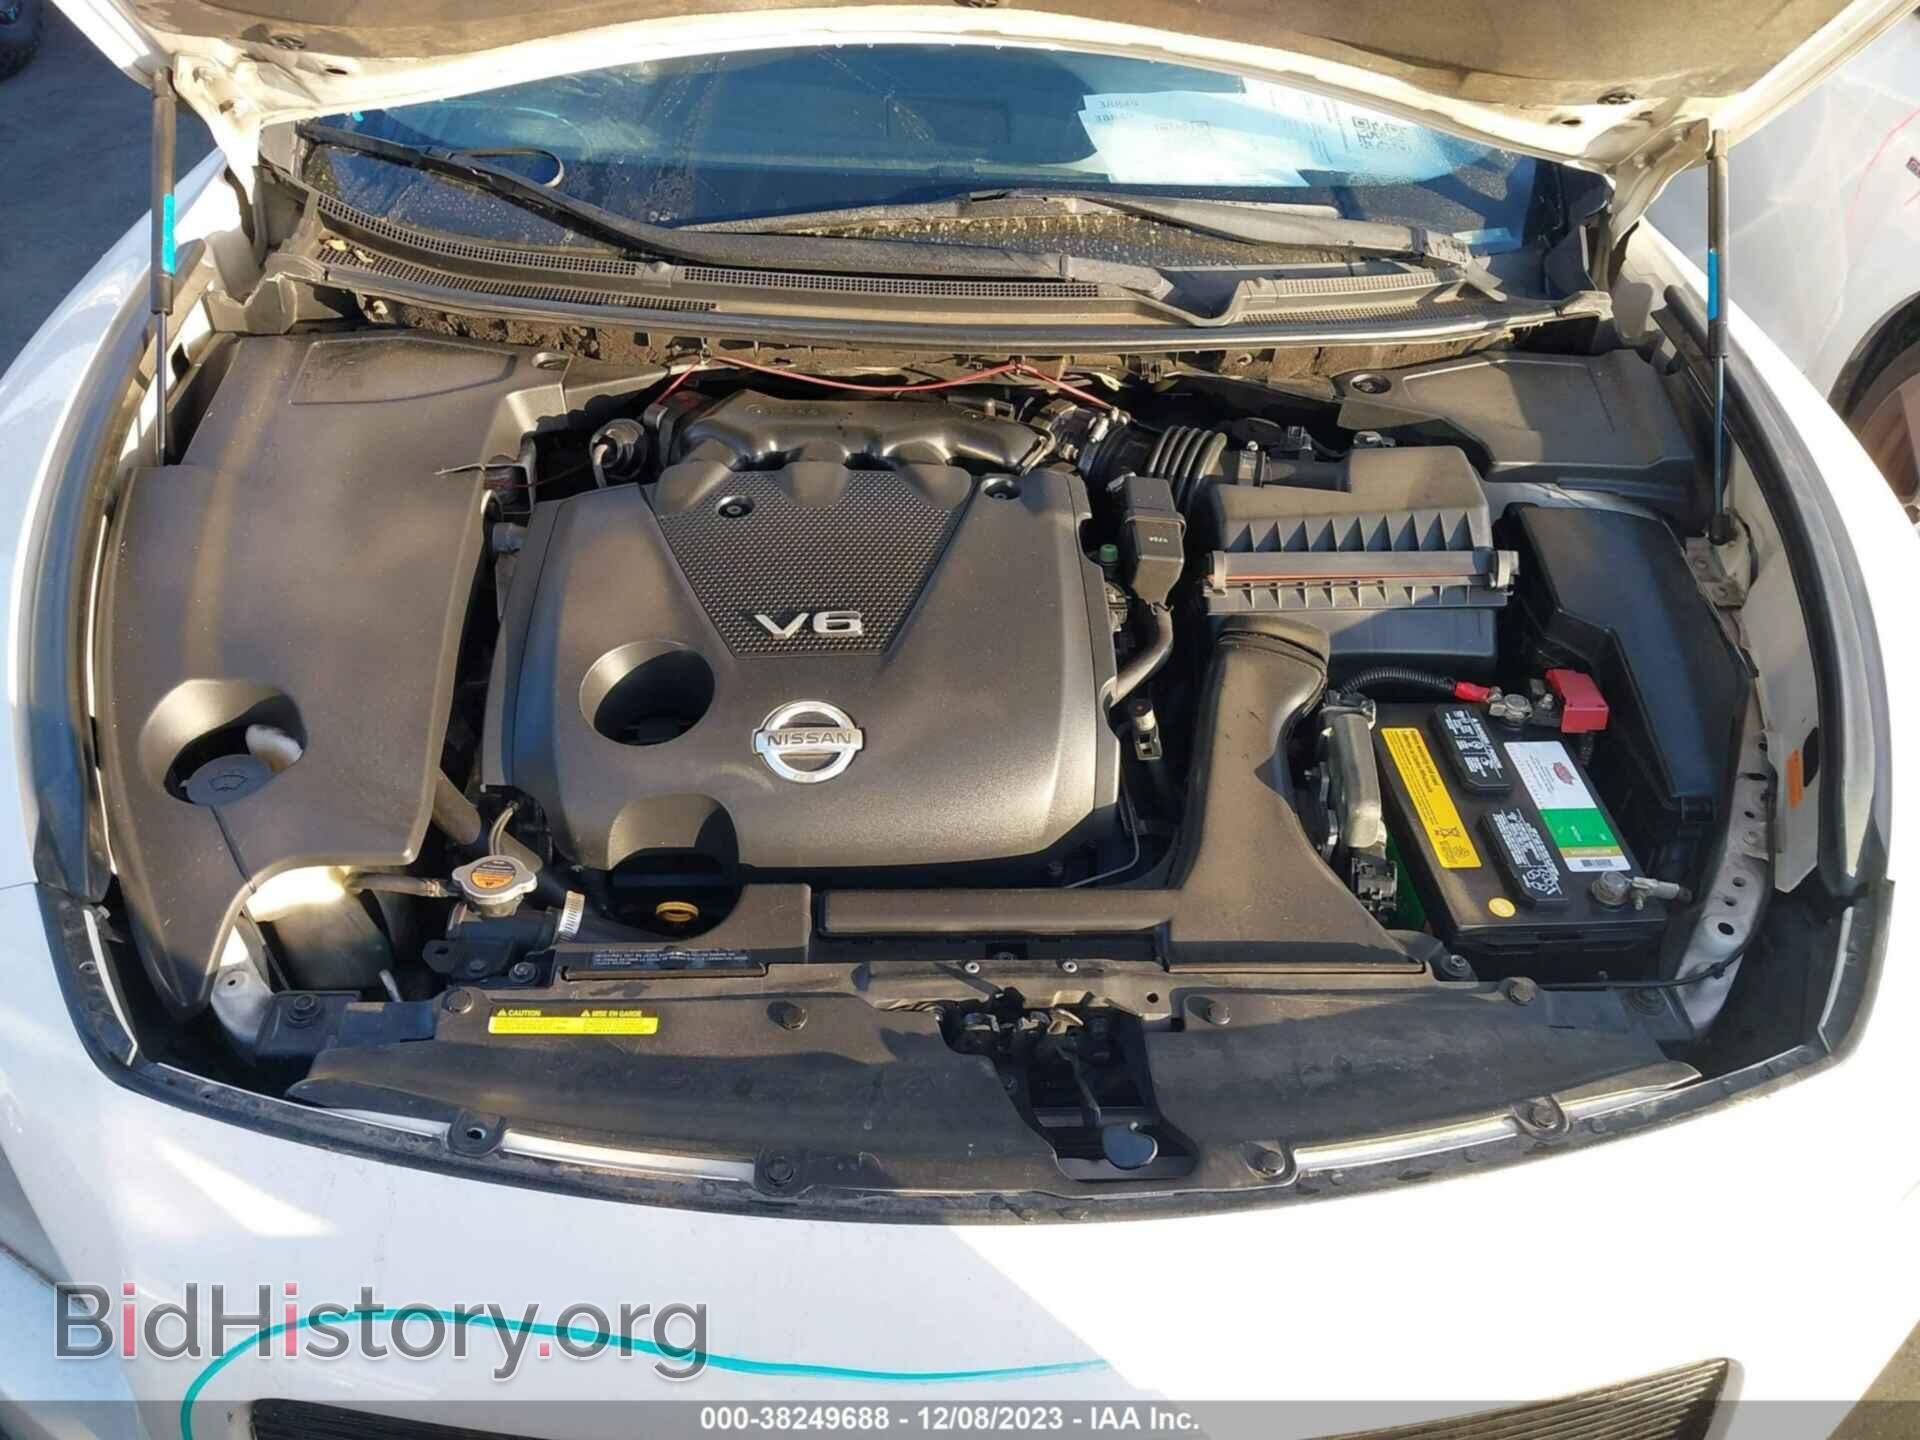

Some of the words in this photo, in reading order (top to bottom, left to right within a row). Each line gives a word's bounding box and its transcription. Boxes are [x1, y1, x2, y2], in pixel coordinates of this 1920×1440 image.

[755, 610, 864, 641] V6
[767, 732, 852, 746] NISSAN
[508, 1009, 542, 1017] CAUTION
